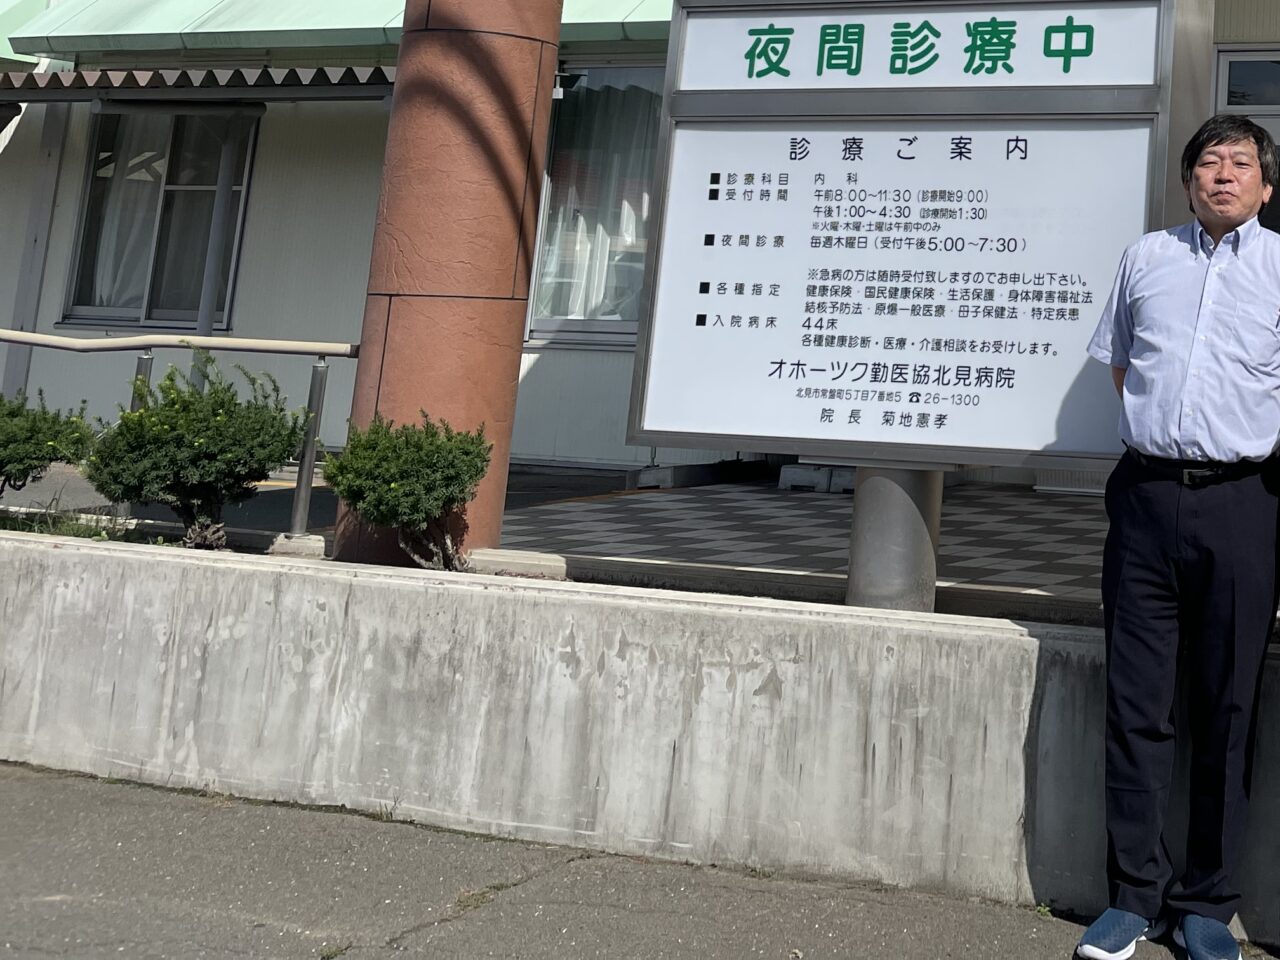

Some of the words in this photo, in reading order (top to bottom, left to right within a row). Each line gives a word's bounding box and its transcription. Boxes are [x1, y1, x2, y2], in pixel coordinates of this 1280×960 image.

[744, 15, 1095, 79] 夜間診療中
[789, 135, 1028, 162] 診療ご案内
[726, 172, 789, 186] 診療科目
[814, 171, 858, 186] 内科
[725, 188, 788, 202] 受付時間
[721, 233, 785, 249] 夜間診療
[716, 282, 781, 297] 各種指定
[712, 314, 778, 329] 入院病床
[801, 316, 838, 331] 44床
[800, 333, 1059, 357] 各種健康診断・医療・介護相談をお受けします。
[767, 358, 1016, 389] オホーツク勤医協北見病院
[795, 386, 902, 403] 北見市常盤町5丁目7番地5
[923, 392, 981, 407] 26-1300
[819, 407, 862, 425] 院長
[881, 410, 949, 430] 菊地憲孝
